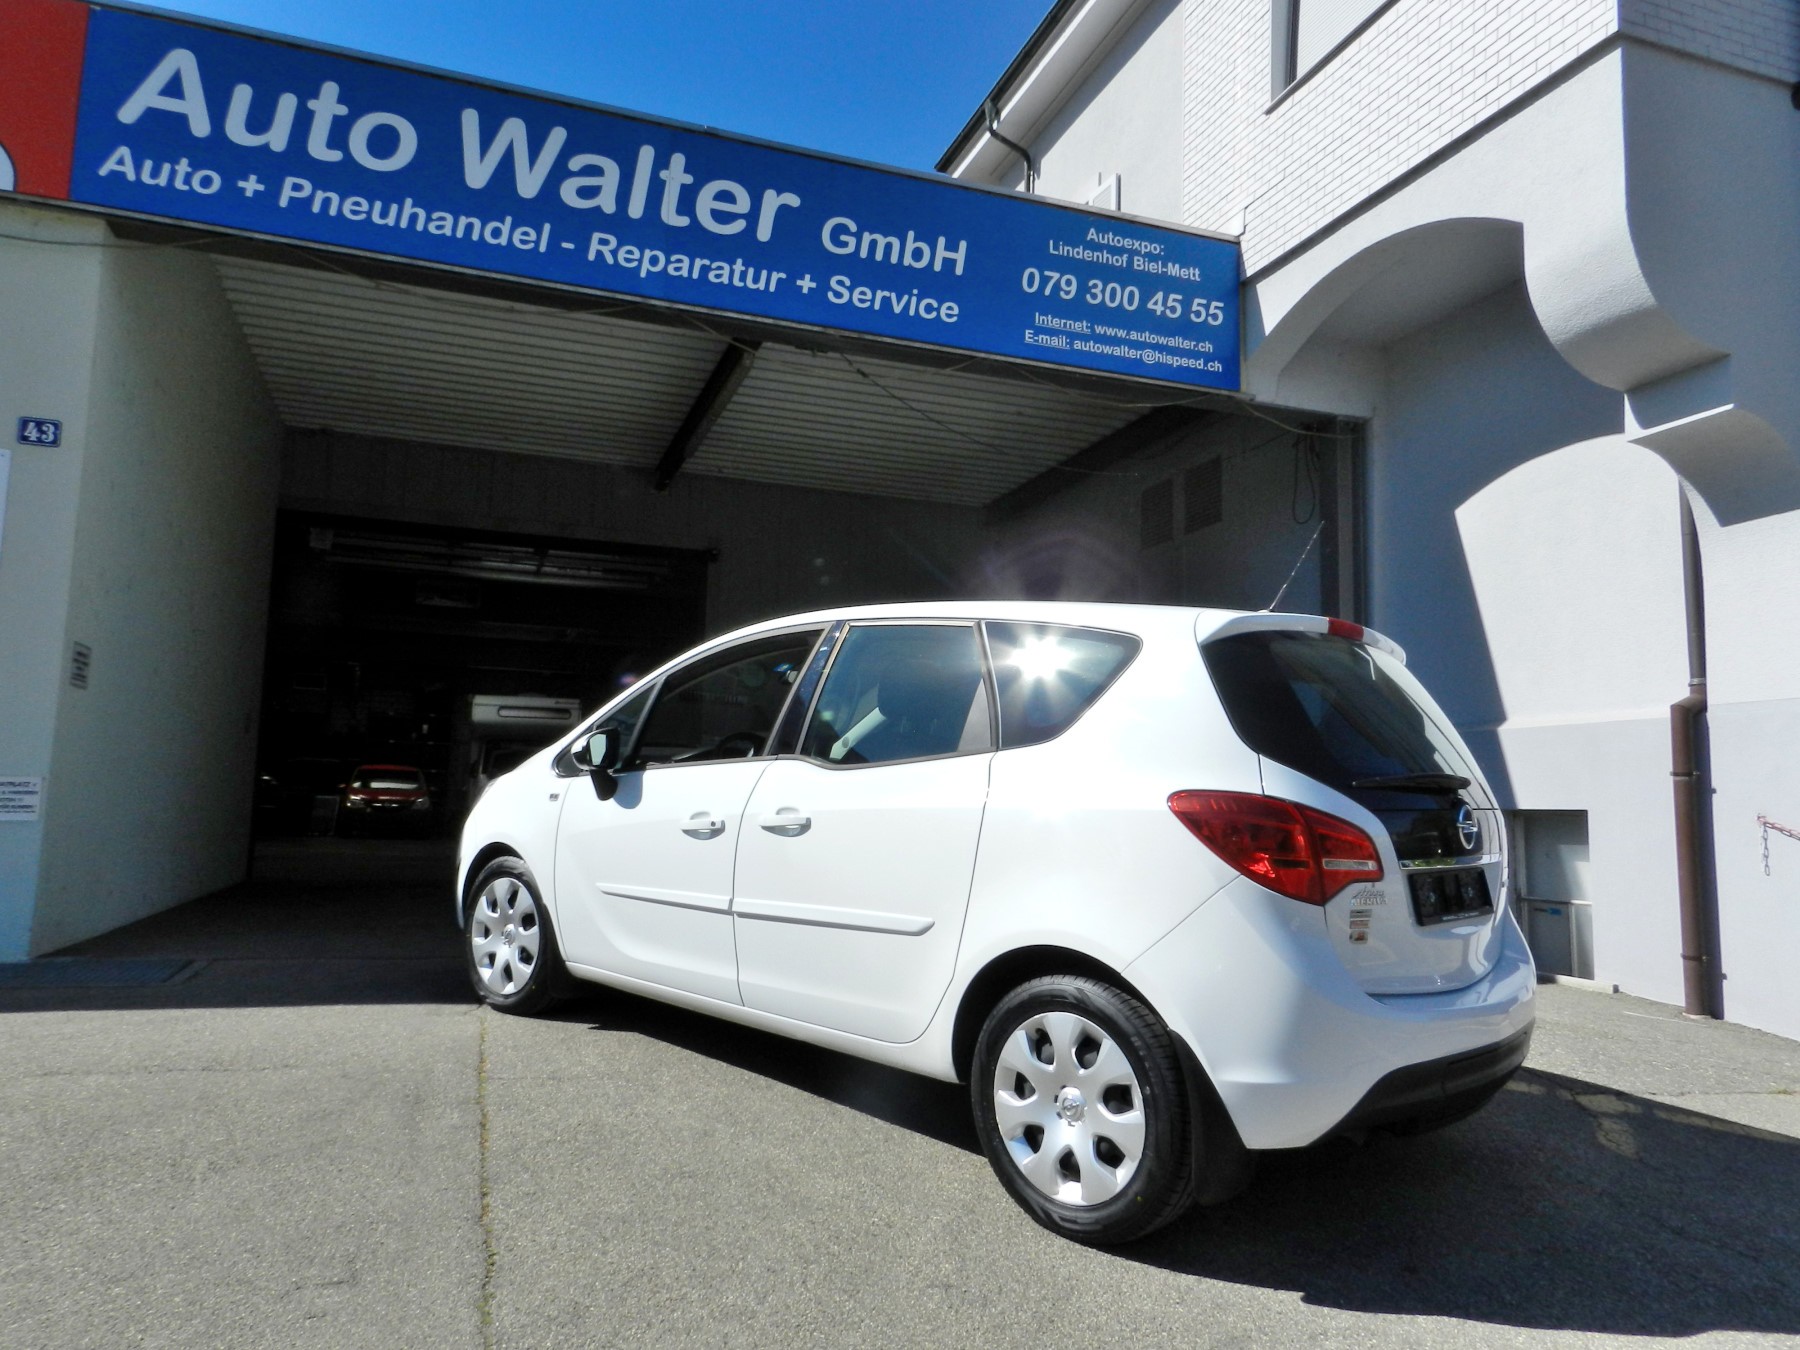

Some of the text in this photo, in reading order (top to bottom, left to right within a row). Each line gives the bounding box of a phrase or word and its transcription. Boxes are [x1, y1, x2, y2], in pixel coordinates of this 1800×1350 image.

[116, 48, 968, 277] Auto Walter GmbH
[97, 145, 222, 195] Auto
[238, 173, 265, 198] +
[279, 175, 552, 254] Pneuhandel
[586, 231, 788, 293] Reparatur
[795, 273, 818, 295] +
[826, 274, 960, 324] Service
[1086, 227, 1165, 256] Autoexpo:
[1049, 239, 1201, 282] Lindenhof Biel-Mett
[1021, 266, 1225, 327] 079 300 45 55
[1025, 329, 1222, 373] E-mail: autowalter@hispeed.ch
[1035, 311, 1213, 353] Internet: www.autowalter.ch
[24, 421, 56, 443] 43
